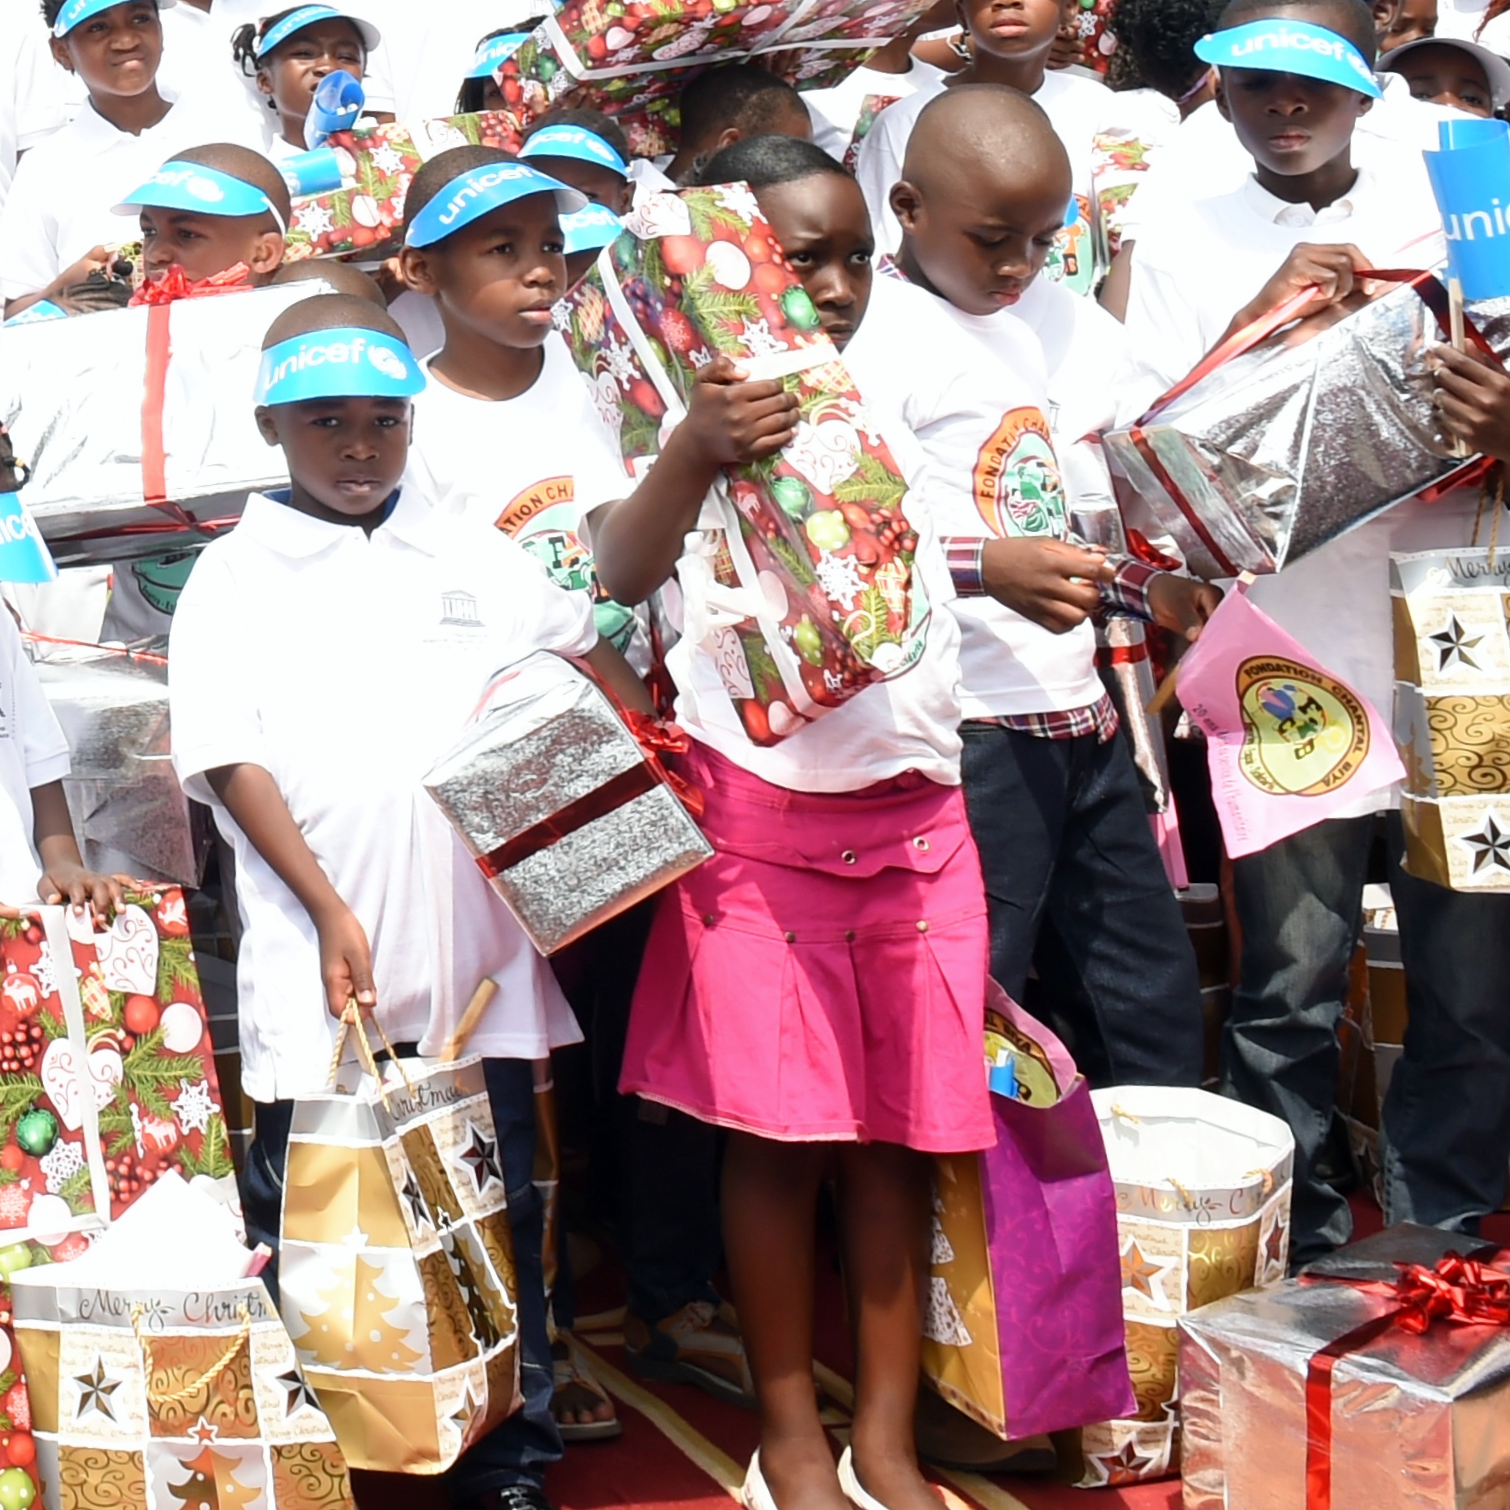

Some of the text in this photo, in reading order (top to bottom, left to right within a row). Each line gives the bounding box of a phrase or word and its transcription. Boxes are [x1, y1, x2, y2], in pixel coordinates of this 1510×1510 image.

[1230, 33, 1343, 61] unicef
[437, 164, 535, 226] unicef
[1443, 197, 1510, 242] uni
[266, 338, 364, 392] unicef
[494, 493, 545, 537] ATION
[1244, 661, 1323, 684] FONDATION
[1329, 684, 1366, 755] CHANTAL
[1320, 761, 1354, 787] BIYA
